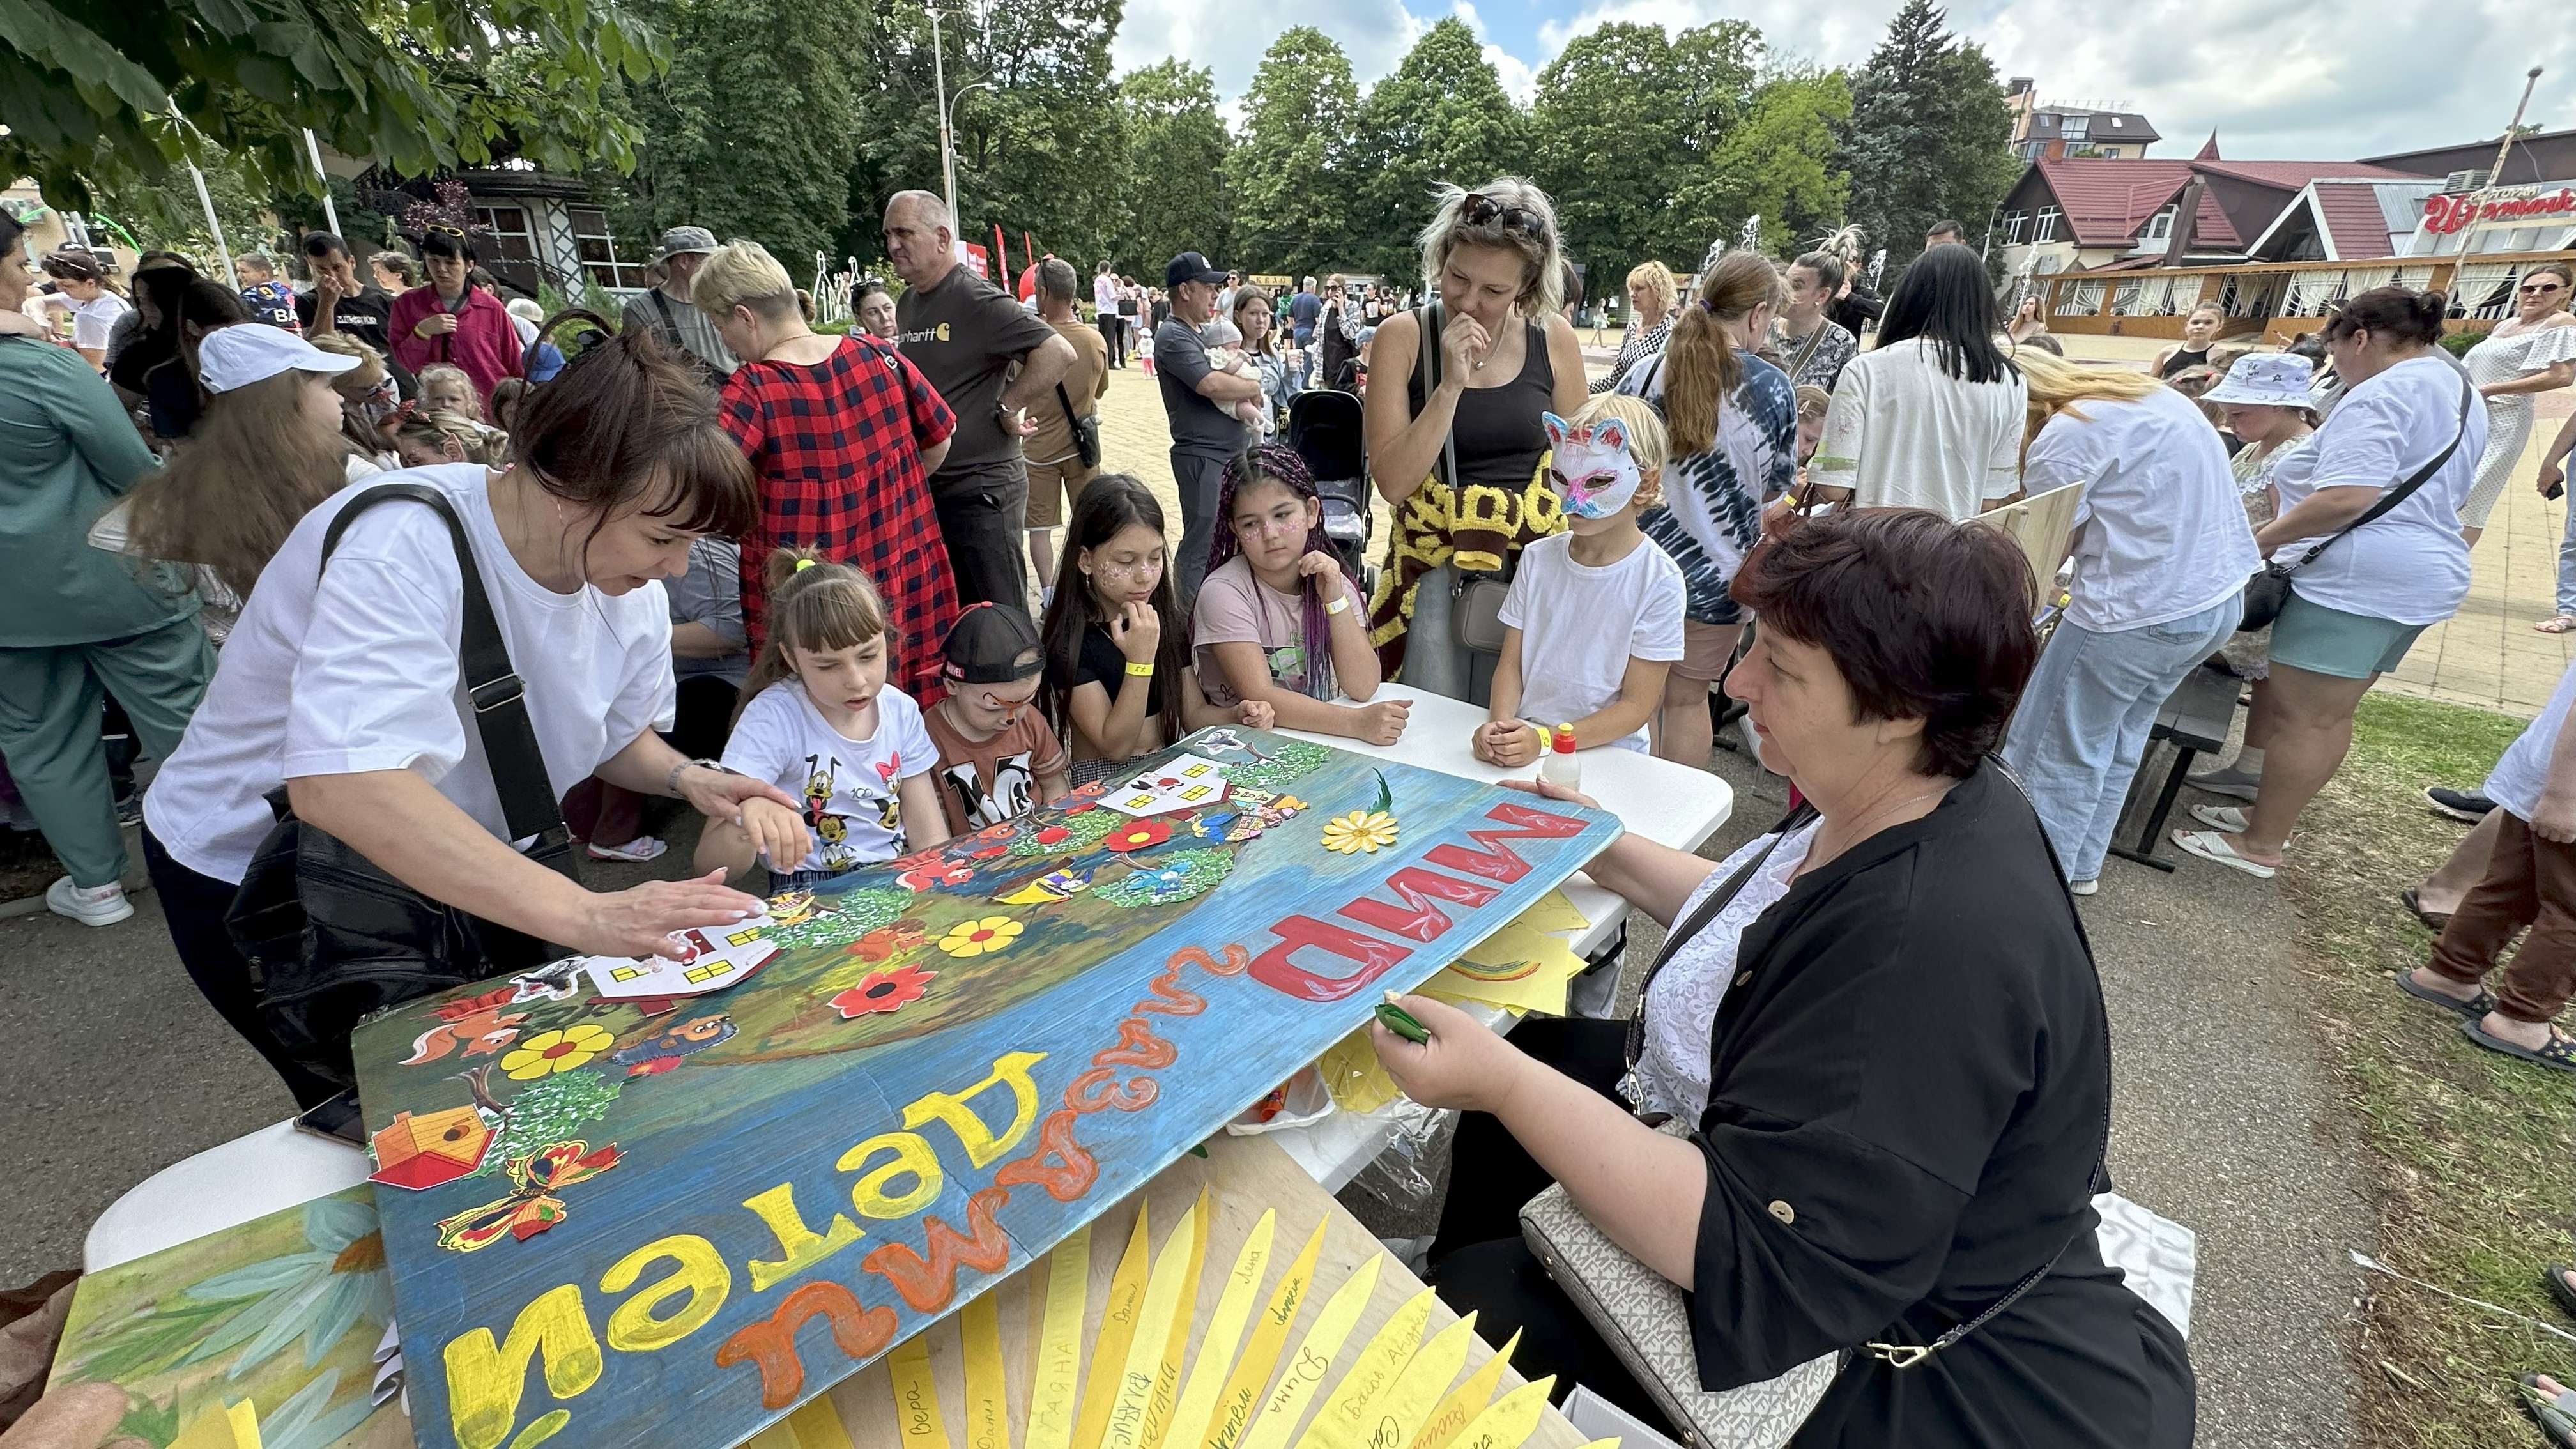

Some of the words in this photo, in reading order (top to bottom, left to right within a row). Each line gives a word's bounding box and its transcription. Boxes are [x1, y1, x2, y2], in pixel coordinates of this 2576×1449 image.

[900, 328, 936, 343] arhartt
[850, 788, 873, 799] 100
[910, 1380, 931, 1436] Вера
[1041, 1342, 1073, 1432] ГАЯНА
[1111, 1372, 1152, 1449] ВЛАДИС
